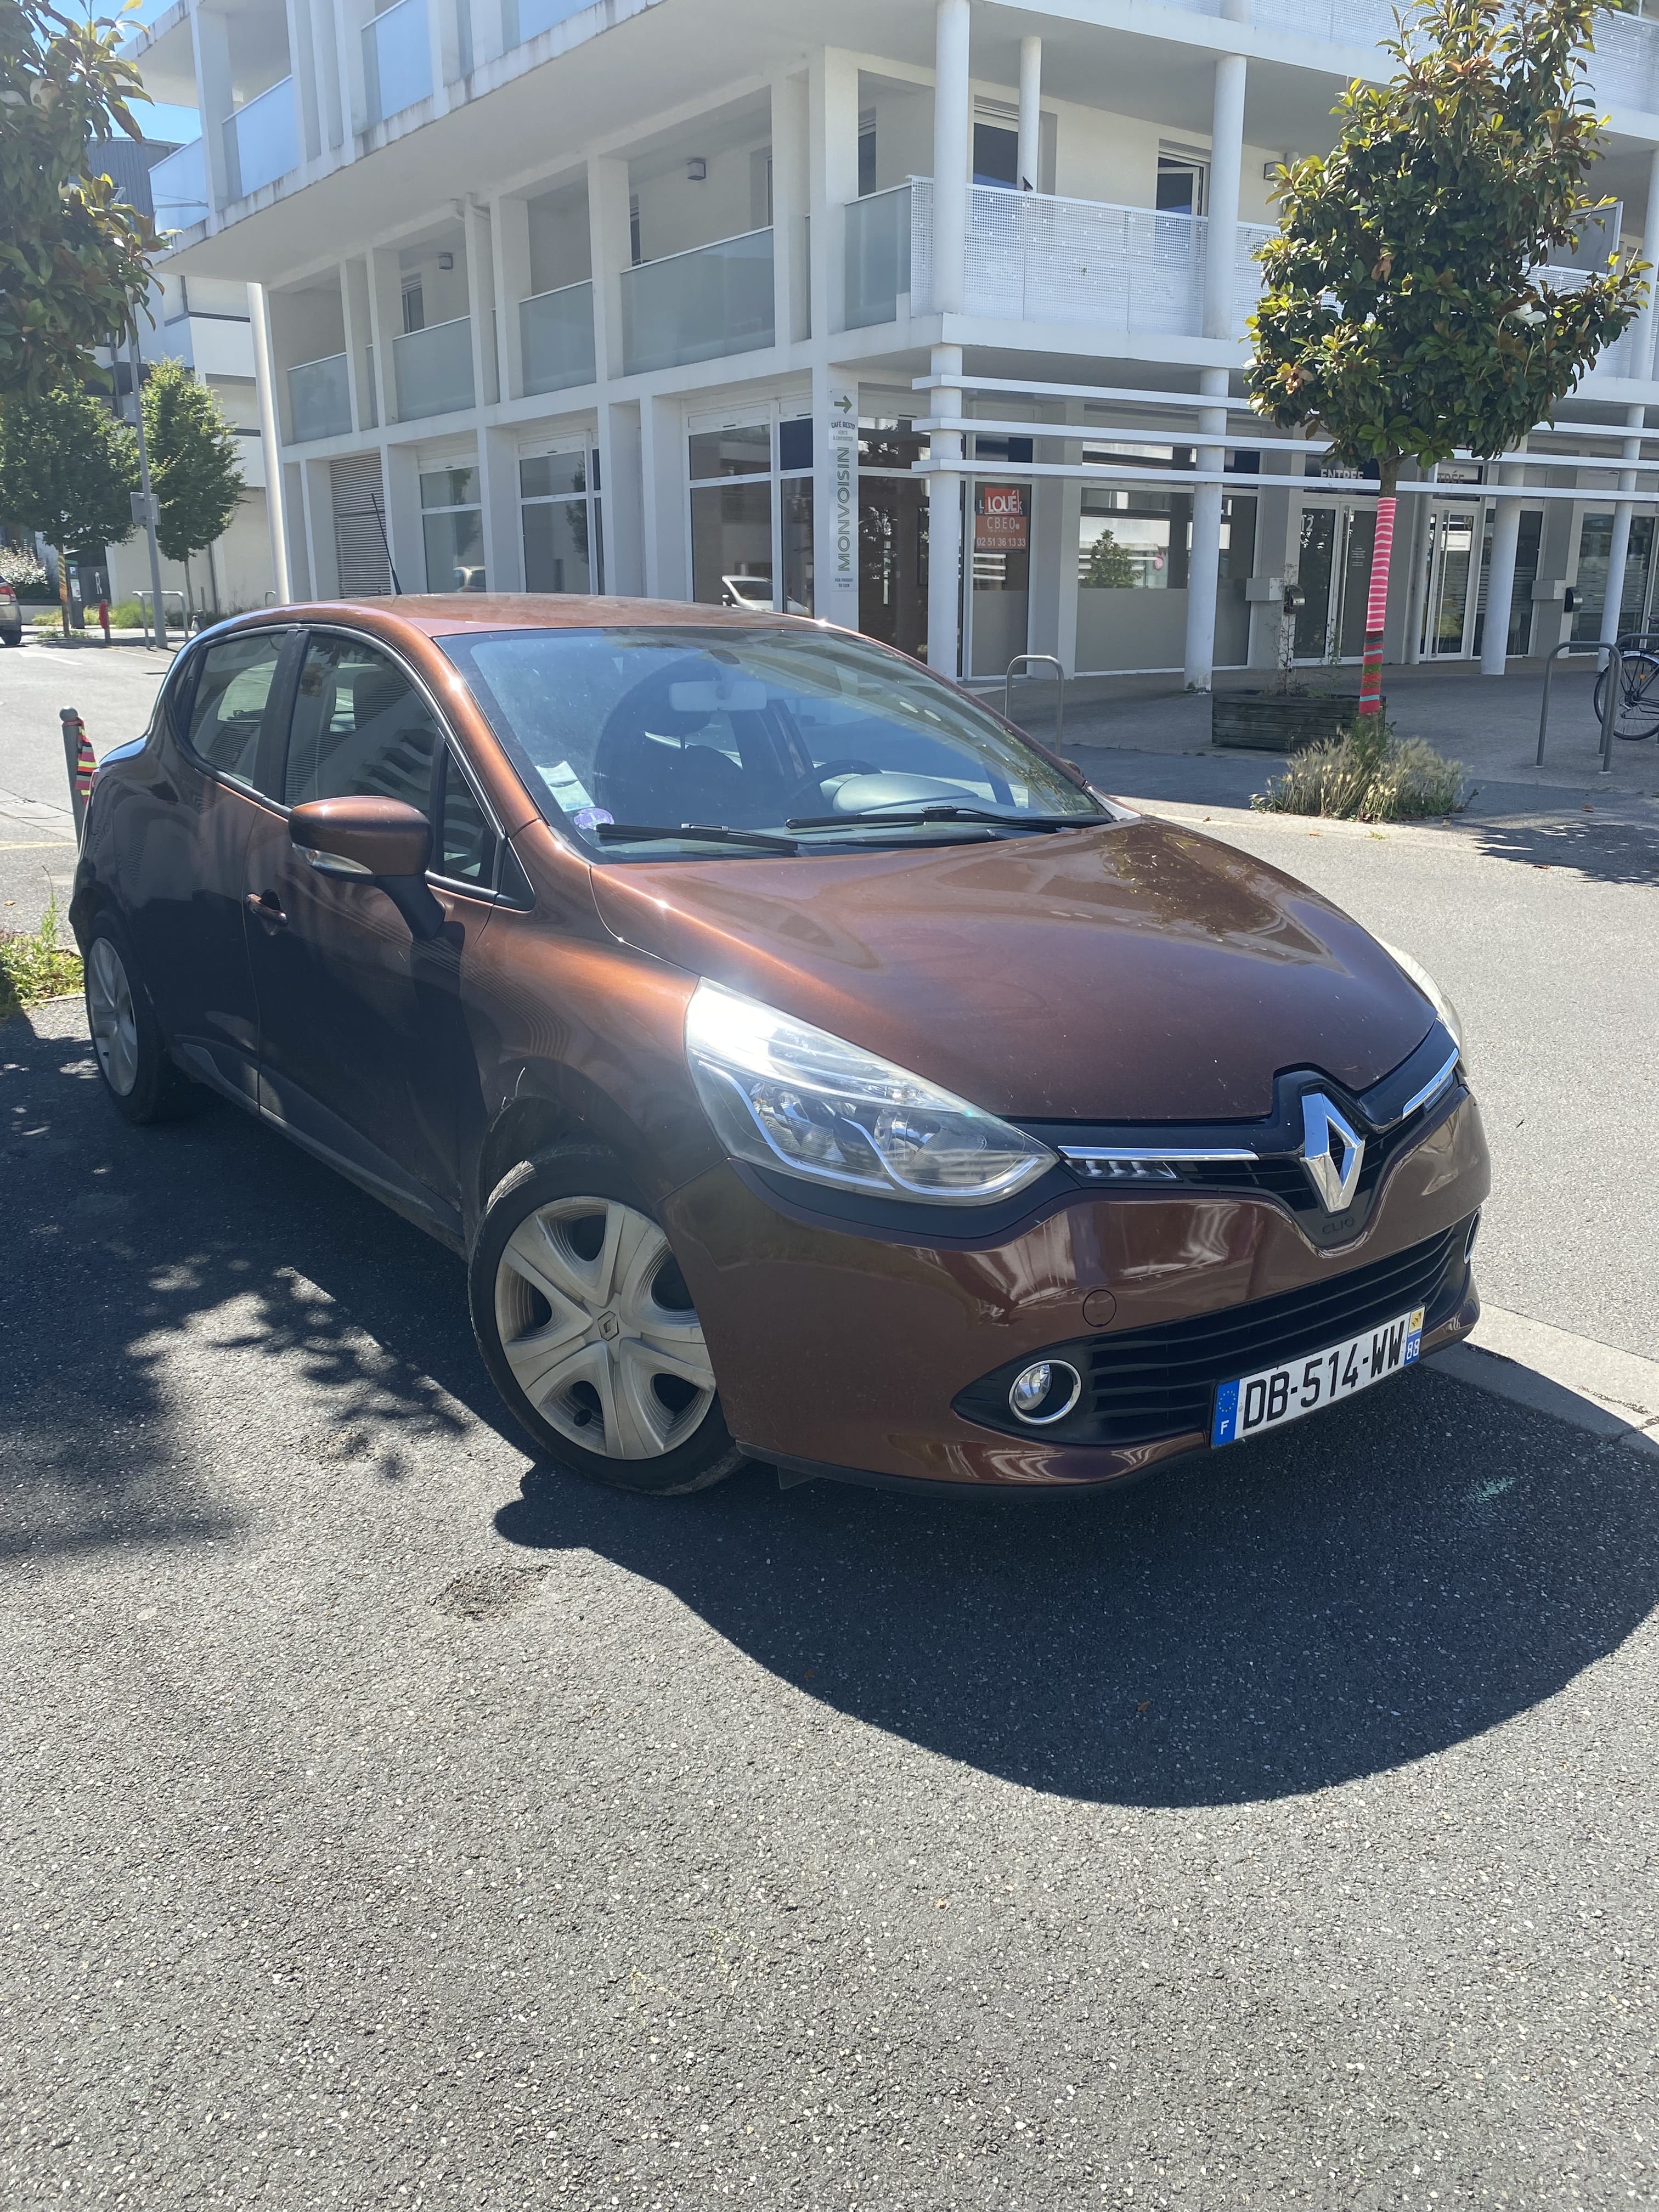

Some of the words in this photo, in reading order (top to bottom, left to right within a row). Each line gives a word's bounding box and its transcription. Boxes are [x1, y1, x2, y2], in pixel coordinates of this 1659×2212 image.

[831, 420, 842, 428] CAFÉ
[843, 421, 856, 430] RESTO
[837, 447, 850, 571] MONVOISIN
[988, 490, 1017, 513] LOUÉ
[987, 517, 1015, 529] CBEO
[977, 537, 986, 546] 02
[988, 537, 996, 546] 51
[998, 538, 1007, 547] 36
[1008, 538, 1017, 547] 13
[1018, 538, 1026, 547] 33
[1322, 1216, 1354, 1234] CLIO
[1220, 1420, 1229, 1435] F
[1243, 1320, 1405, 1430] DB-514-WW
[1406, 1338, 1420, 1360] 88
